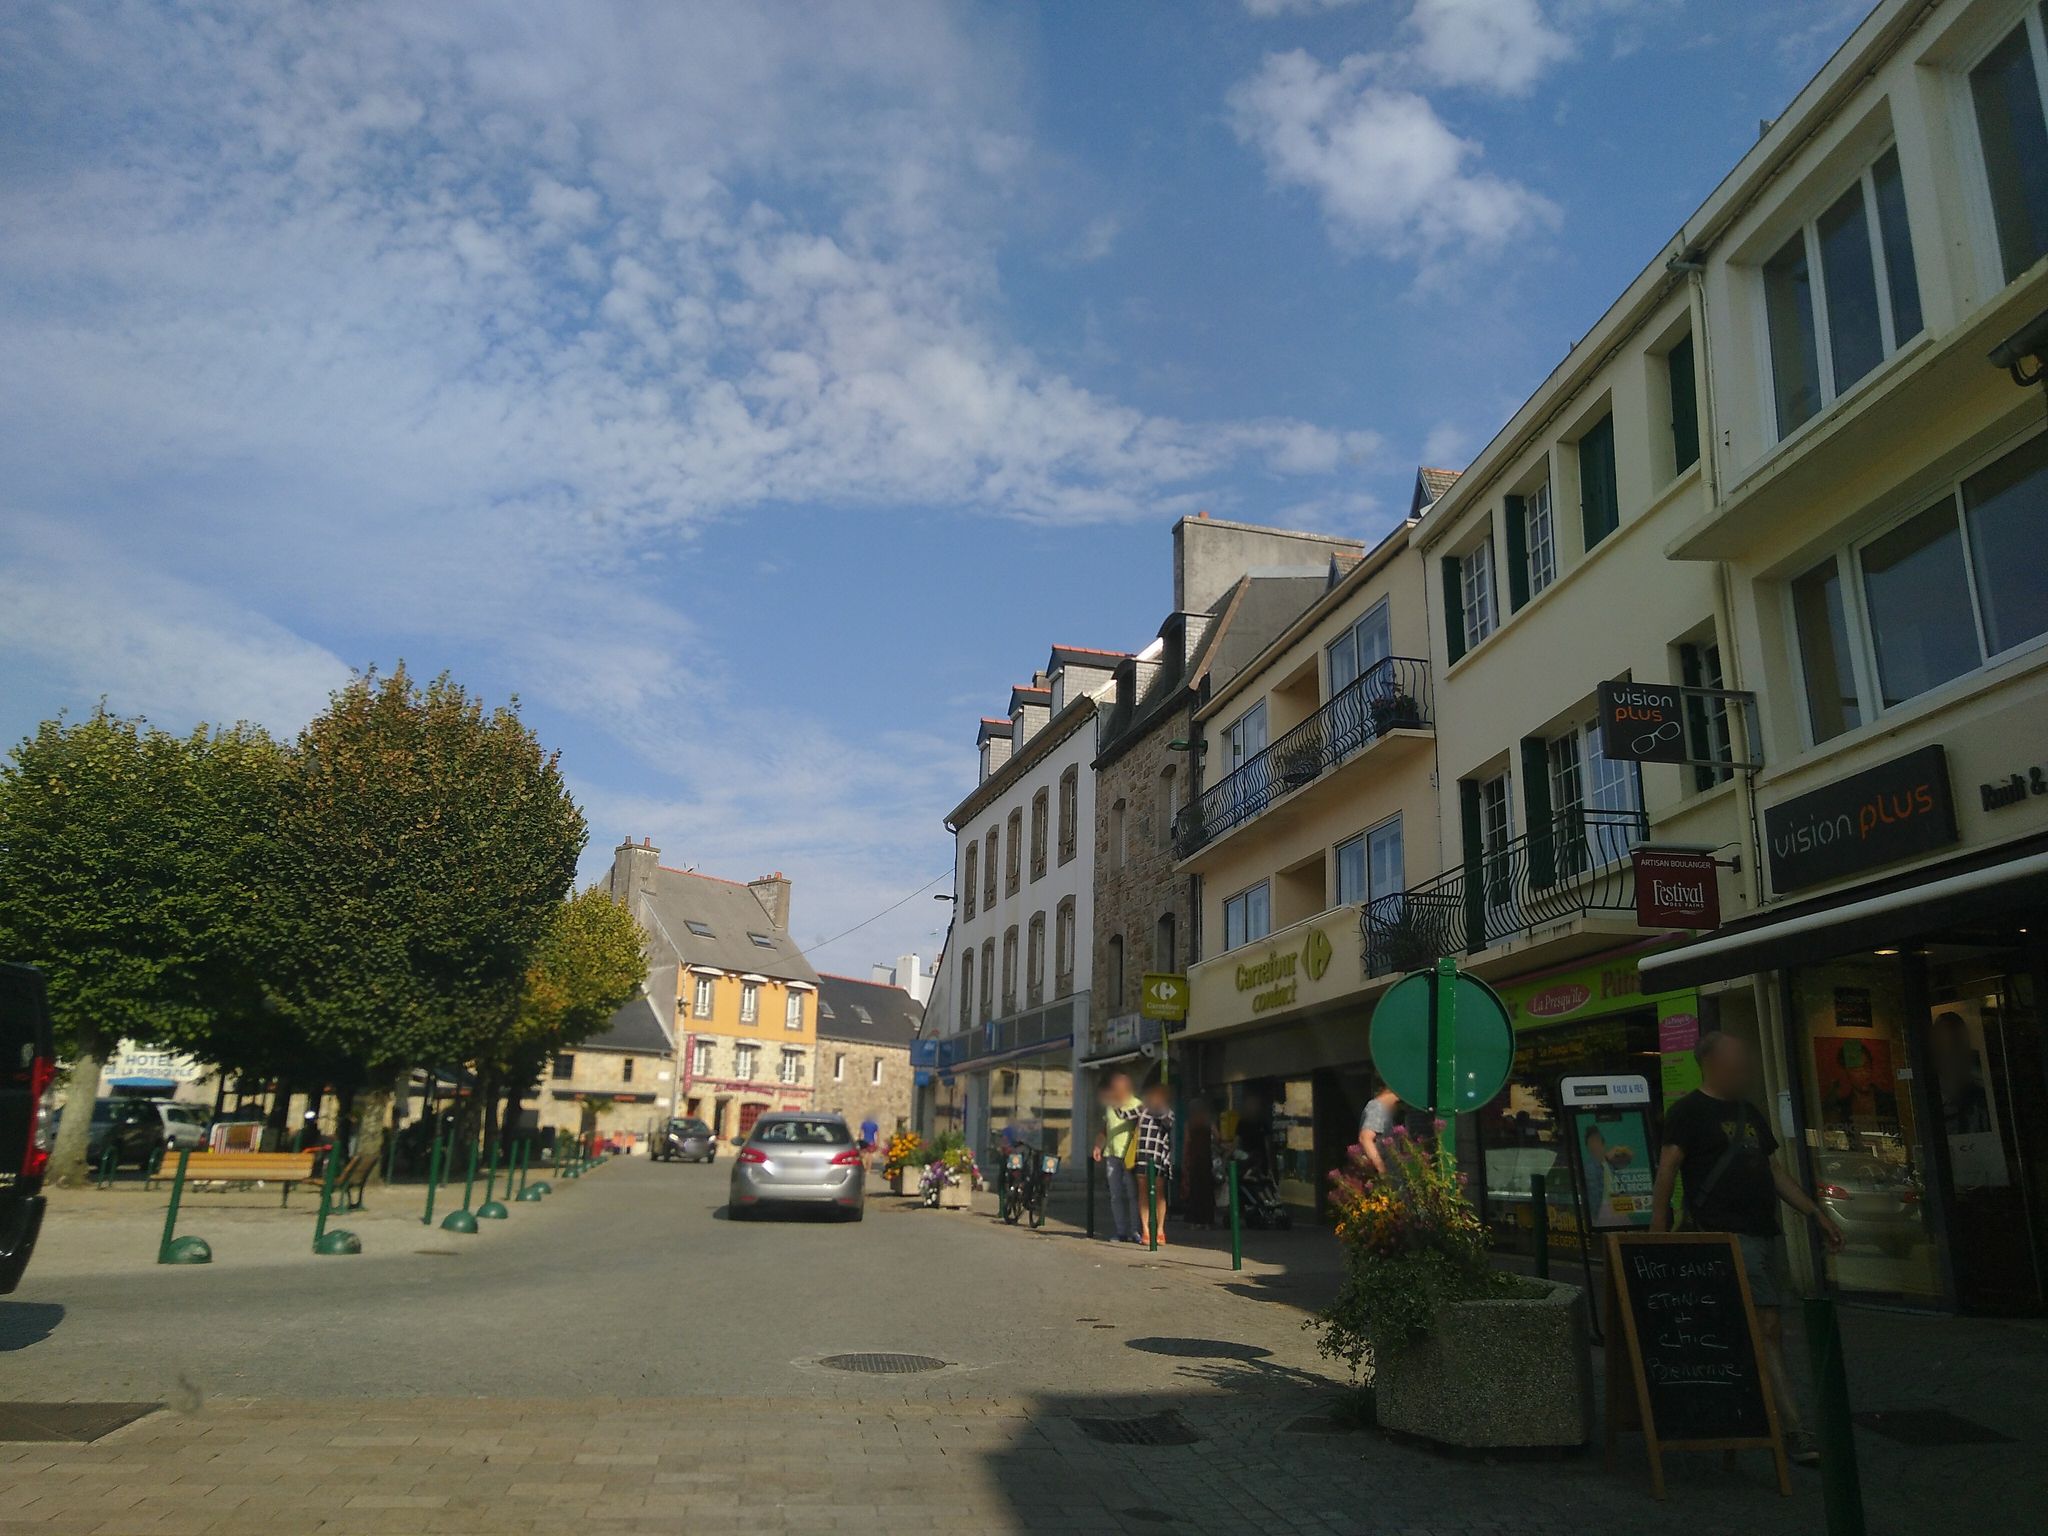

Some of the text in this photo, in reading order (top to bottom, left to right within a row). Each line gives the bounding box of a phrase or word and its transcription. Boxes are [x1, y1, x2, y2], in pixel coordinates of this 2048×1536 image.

[1613, 687, 1673, 708] vision
[1616, 706, 1664, 723] plus
[1774, 784, 1935, 858] vision plus
[1641, 858, 1711, 869] ARTISAN BOULANGER
[1653, 879, 1705, 907] Festival
[1235, 951, 1298, 992] Carrefour
[1252, 977, 1297, 1014] contact
[1532, 997, 1543, 1014] La
